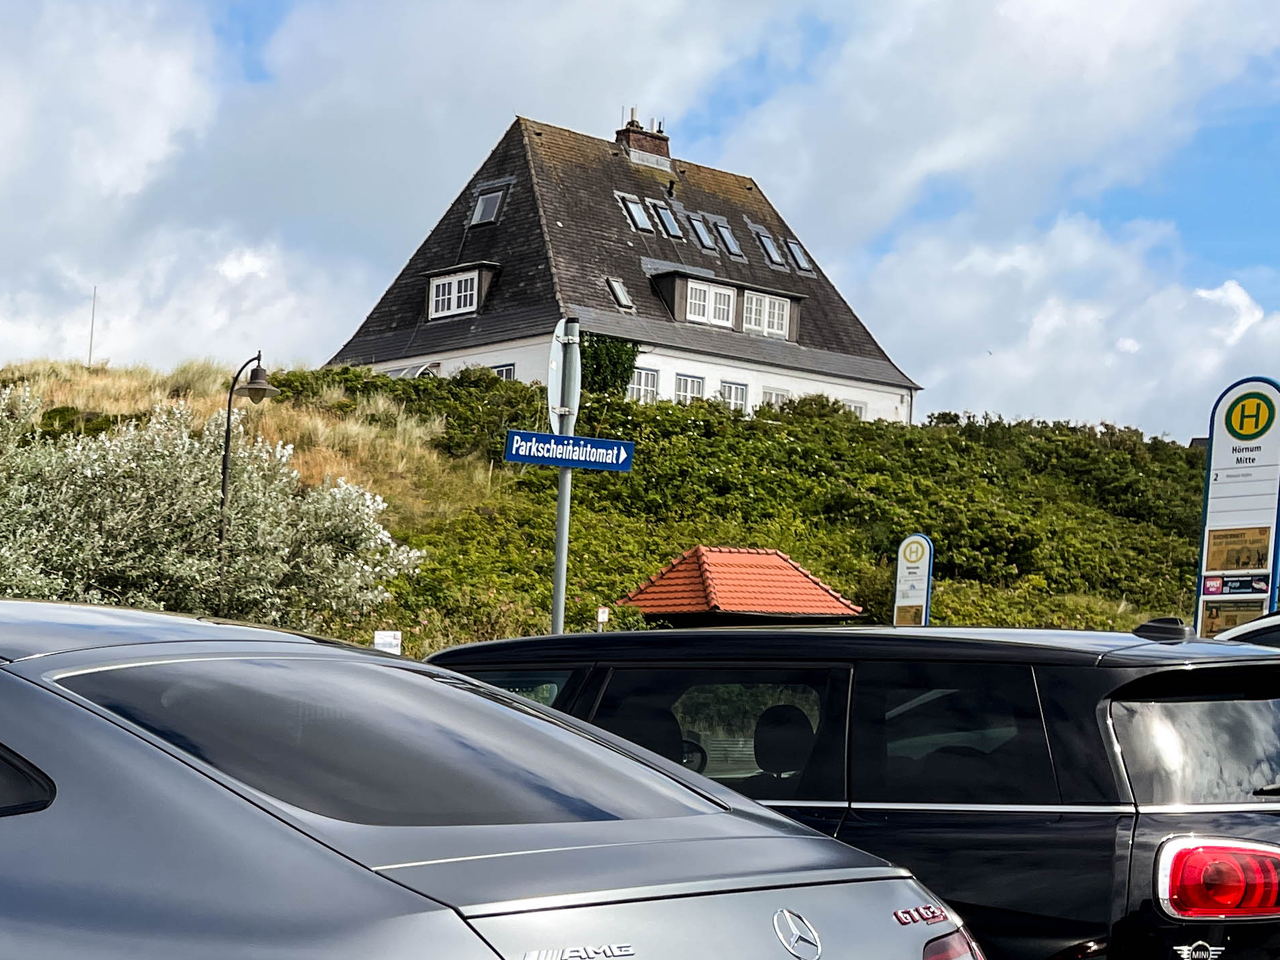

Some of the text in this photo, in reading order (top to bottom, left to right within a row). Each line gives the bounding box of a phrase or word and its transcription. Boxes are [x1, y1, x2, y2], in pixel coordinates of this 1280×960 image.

[1238, 402, 1261, 431] H
[511, 435, 618, 464] Parkscheinautomat
[1232, 445, 1262, 454] Hörnum
[1235, 456, 1256, 465] Mitte
[1213, 472, 1219, 482] 2
[909, 545, 919, 560] H
[1191, 950, 1209, 959] MINI
